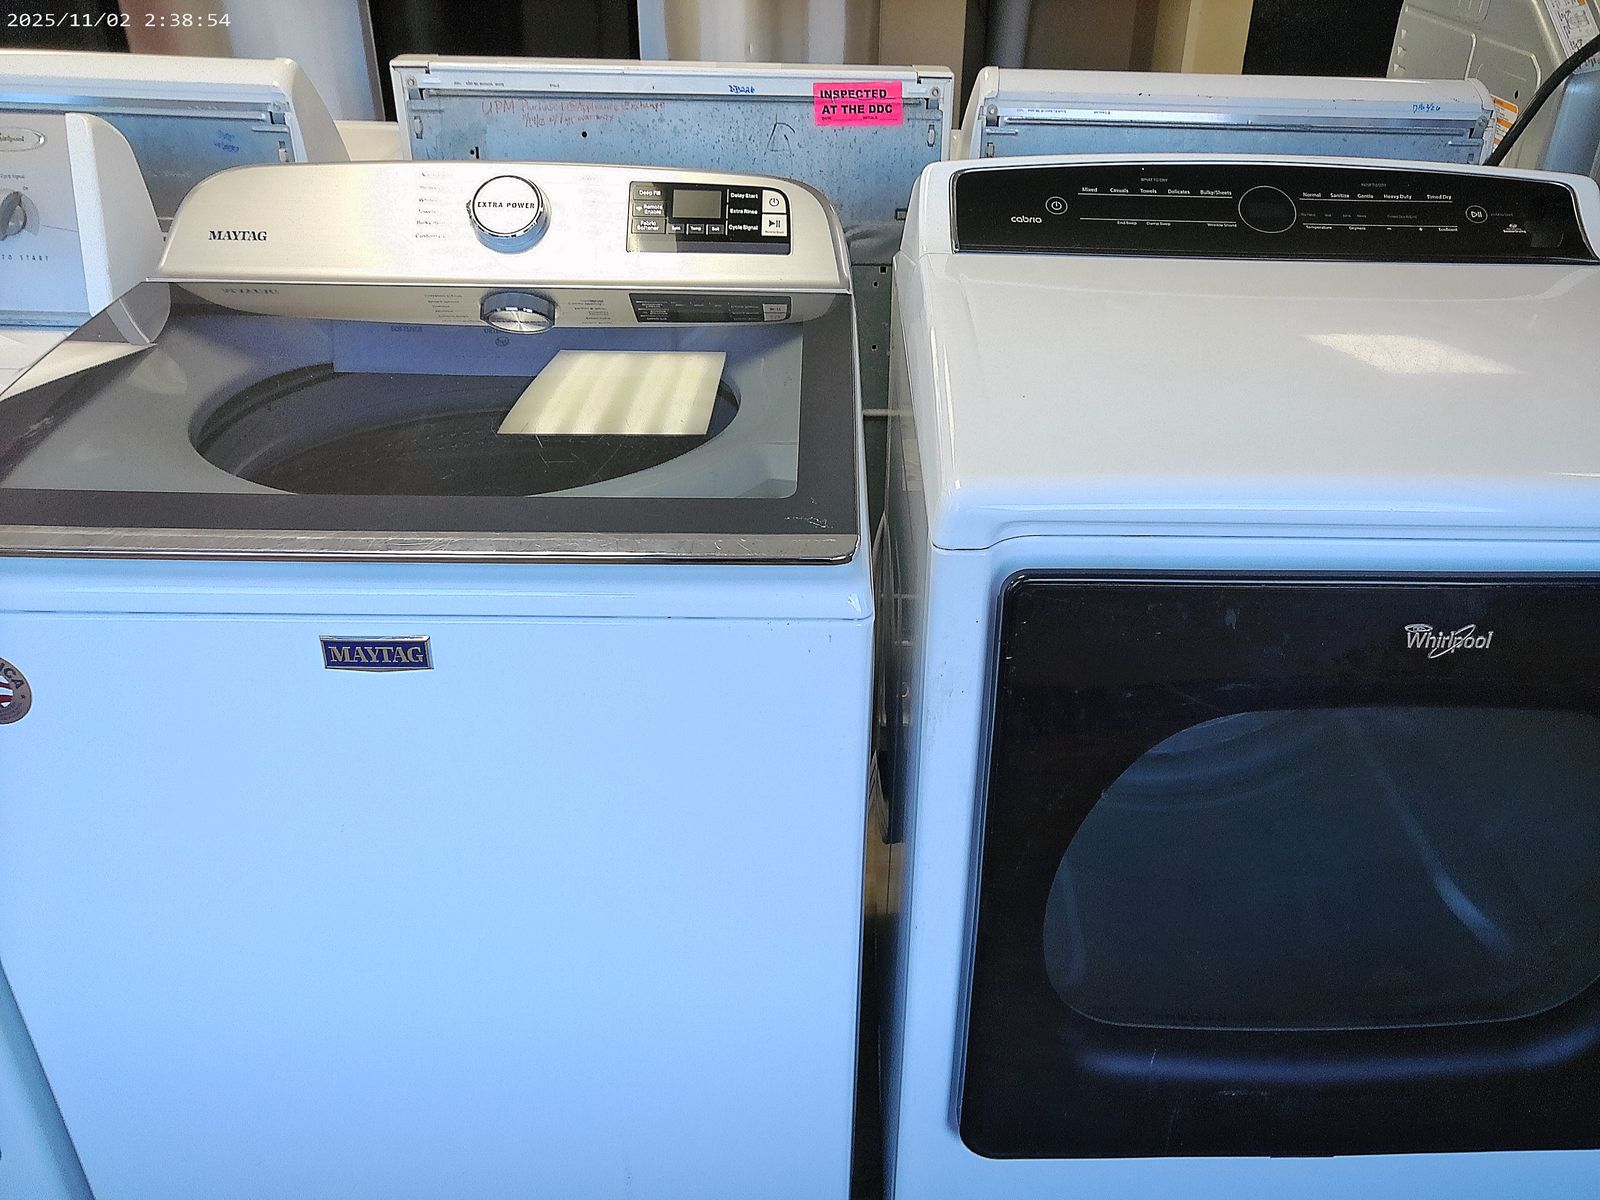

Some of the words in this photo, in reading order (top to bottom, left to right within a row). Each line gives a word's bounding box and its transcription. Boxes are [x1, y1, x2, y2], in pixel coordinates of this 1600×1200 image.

[820, 89, 887, 99] INSPECTED
[821, 104, 838, 115] AT
[841, 104, 865, 115] THE
[868, 104, 893, 114] DDC
[1010, 215, 1042, 223] cabrio
[208, 230, 267, 241] MAYTAG
[20, 254, 49, 262] START
[1405, 626, 1494, 656] Whirlpool
[327, 646, 424, 663] MAYTAG
